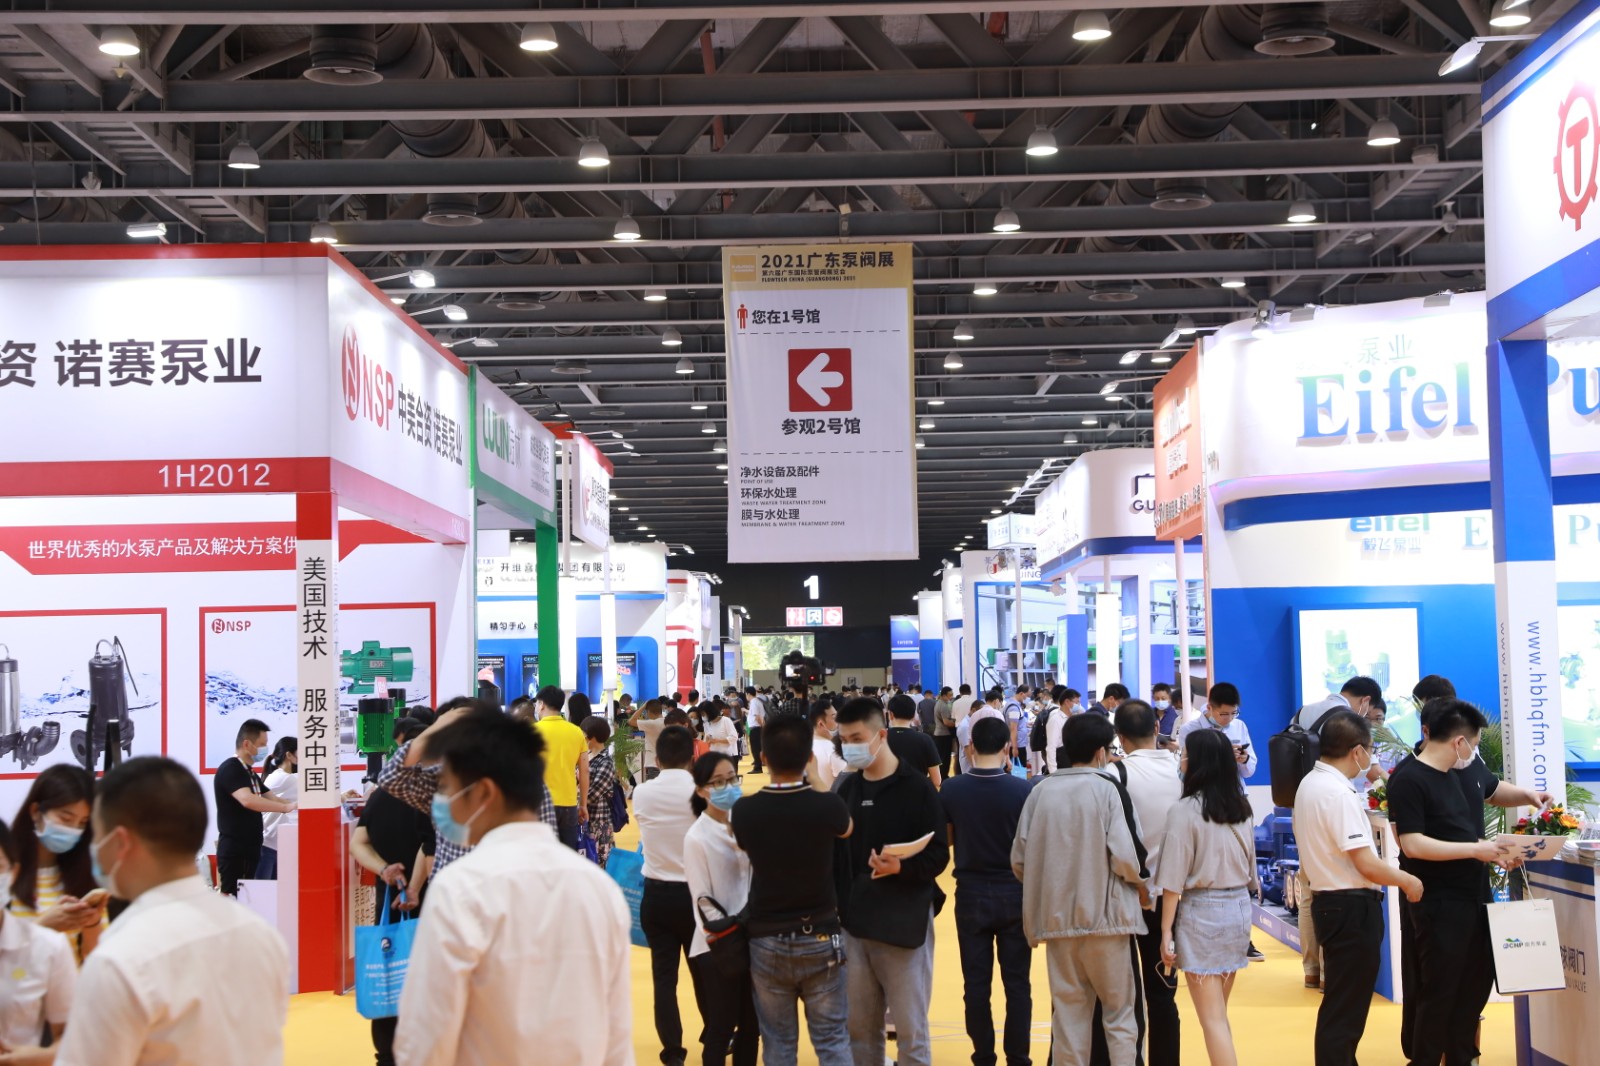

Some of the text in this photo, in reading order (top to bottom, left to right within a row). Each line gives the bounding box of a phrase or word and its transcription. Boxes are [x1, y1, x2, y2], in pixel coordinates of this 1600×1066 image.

[761, 251, 894, 269] 2021广东泵阀展
[752, 309, 820, 325] 您在1号馆
[54, 338, 262, 387] 诺赛泵业
[363, 354, 395, 432] NSP
[1297, 362, 1475, 439] Eifel
[398, 383, 432, 450] 中美合资
[434, 407, 463, 467] 诺赛泵业
[781, 417, 861, 435] 参观2号馆
[158, 463, 270, 488] 1H2012
[740, 465, 820, 478] 净水设备及配件
[740, 487, 797, 499] 环保水处理
[741, 508, 800, 521] 膜与水处理
[28, 536, 297, 559] 世界优秀的水泵产品及解决方案供
[803, 575, 819, 600] 1
[226, 620, 252, 632] NSP
[303, 556, 328, 792] 美国技术 服务中国
[1527, 620, 1550, 792] www.hbhqfm.com
